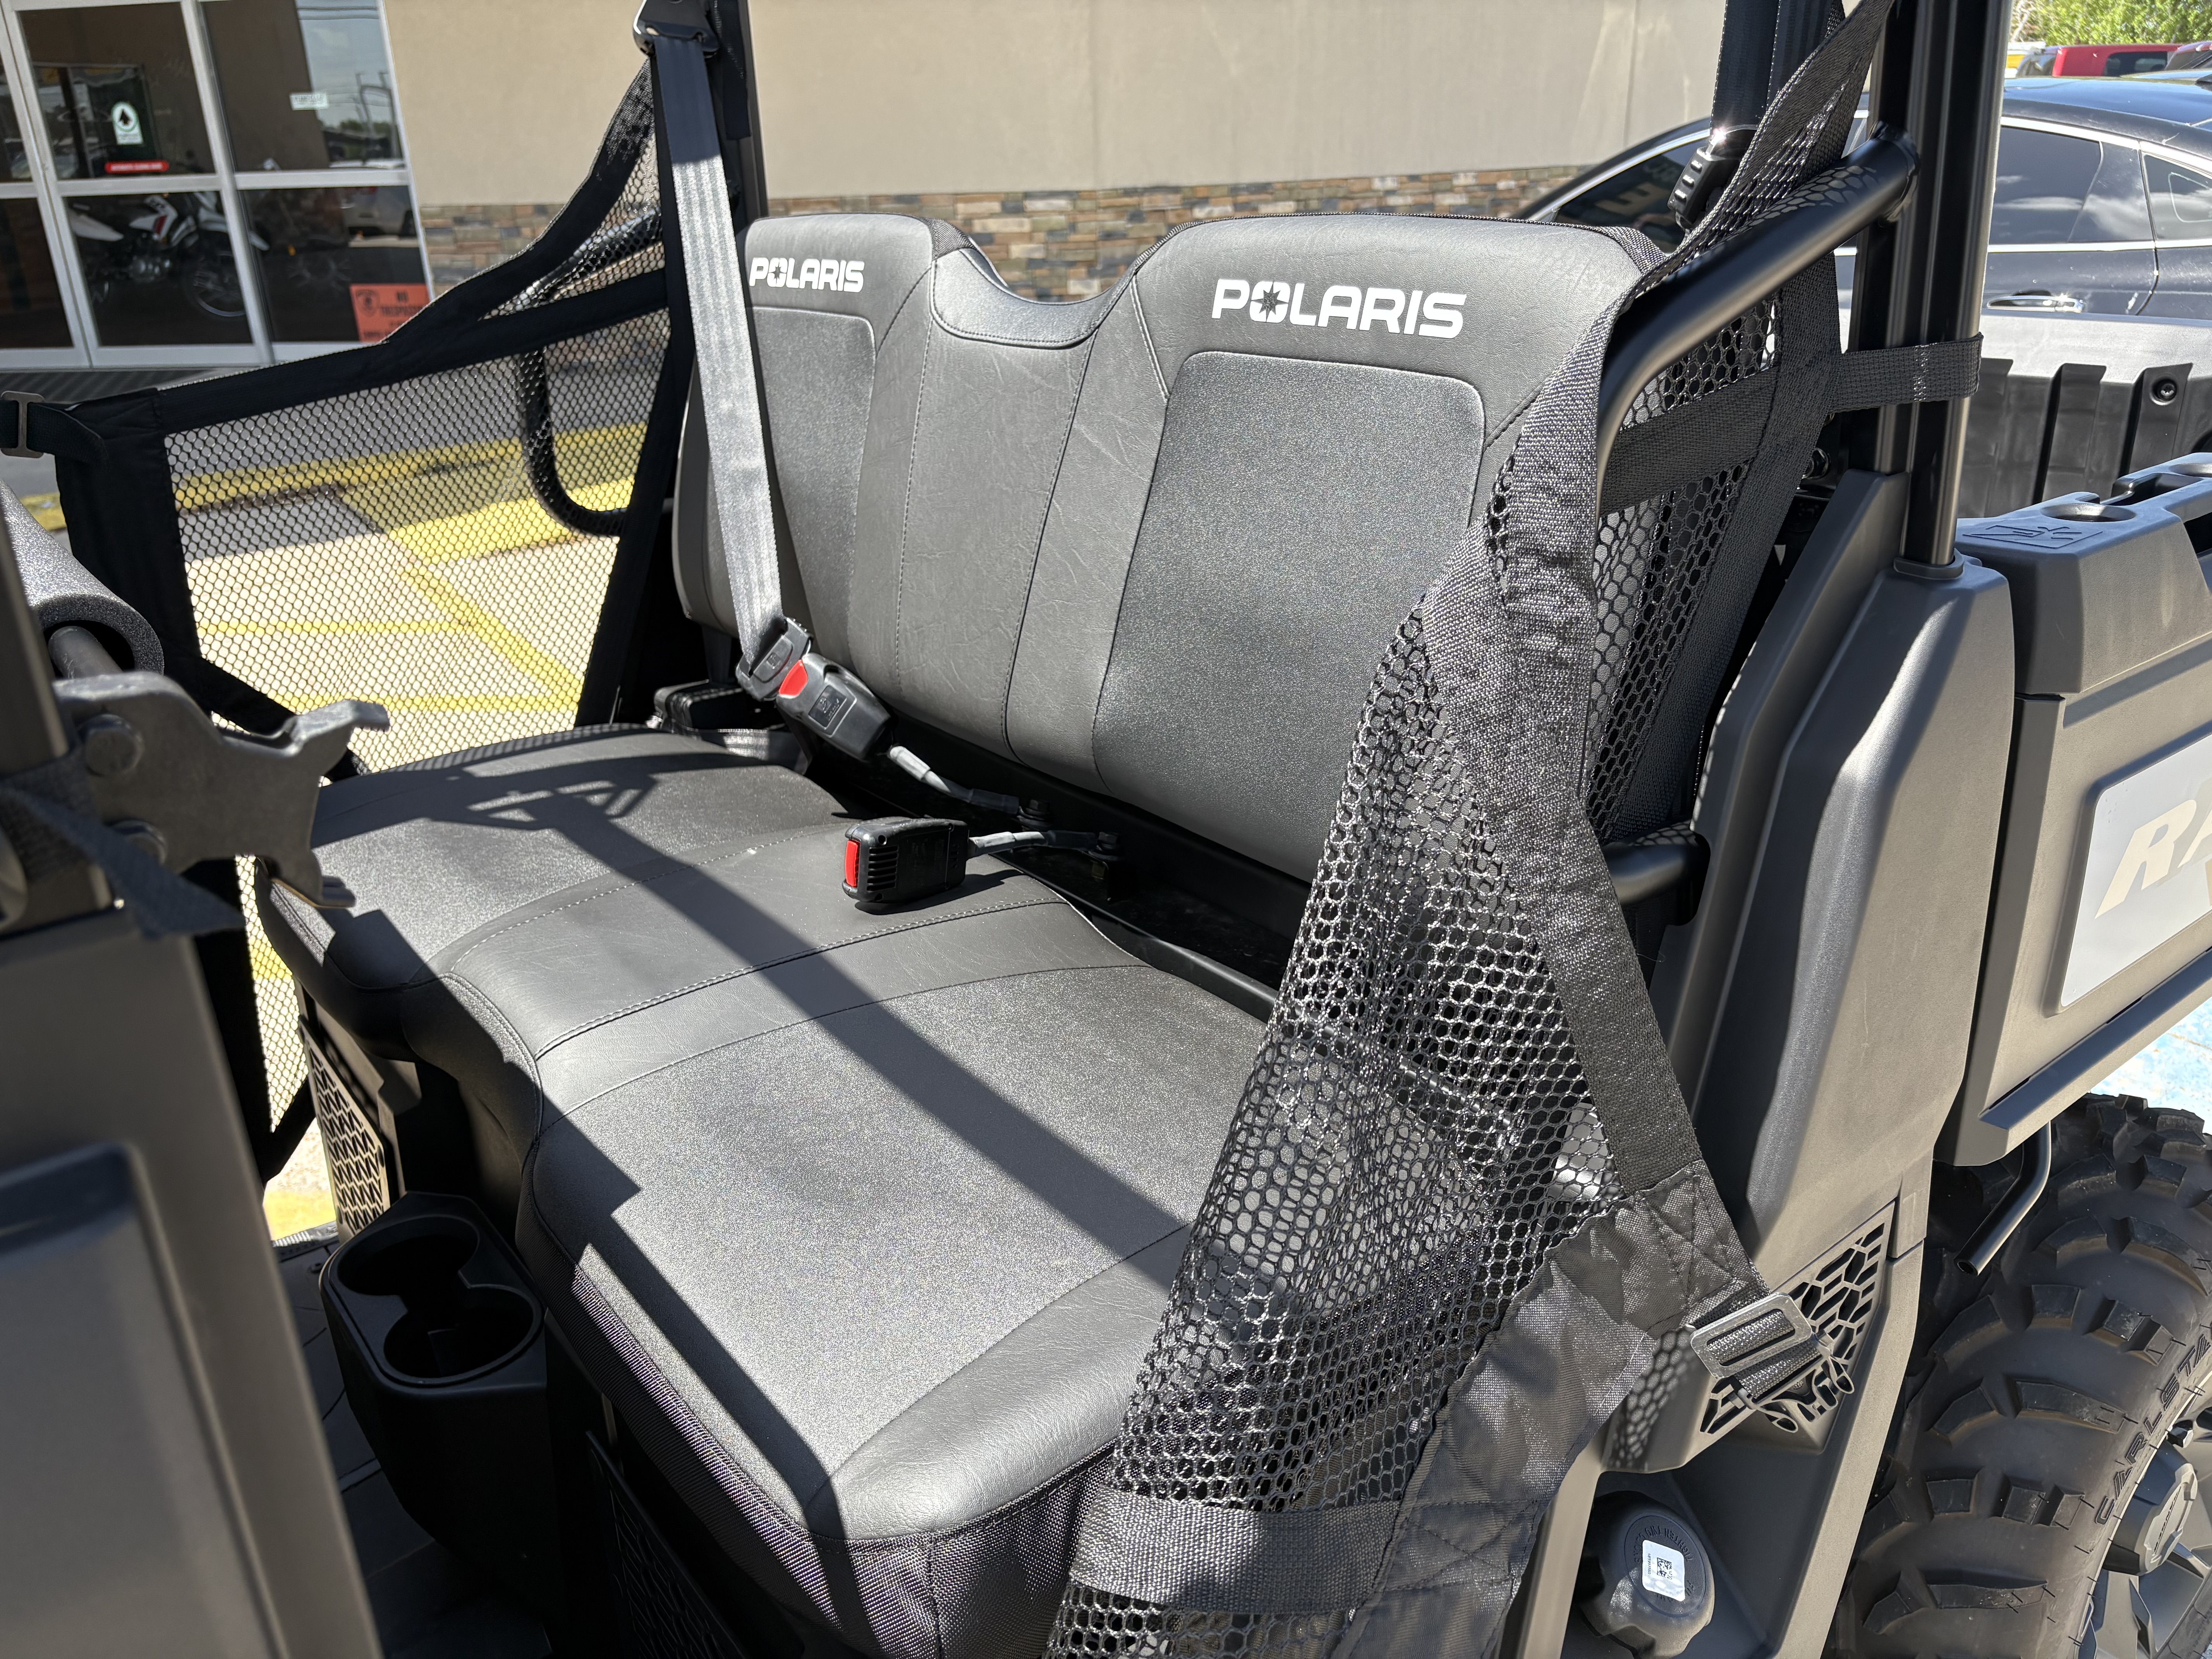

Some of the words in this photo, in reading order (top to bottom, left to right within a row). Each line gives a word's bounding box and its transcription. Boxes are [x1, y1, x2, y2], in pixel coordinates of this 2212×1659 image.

[749, 257, 865, 292] POLARIS
[1211, 278, 1467, 339] POLARIS
[2095, 1321, 2212, 1525] CARLSTA
[1665, 1528, 1693, 1563] TIGHTEN
